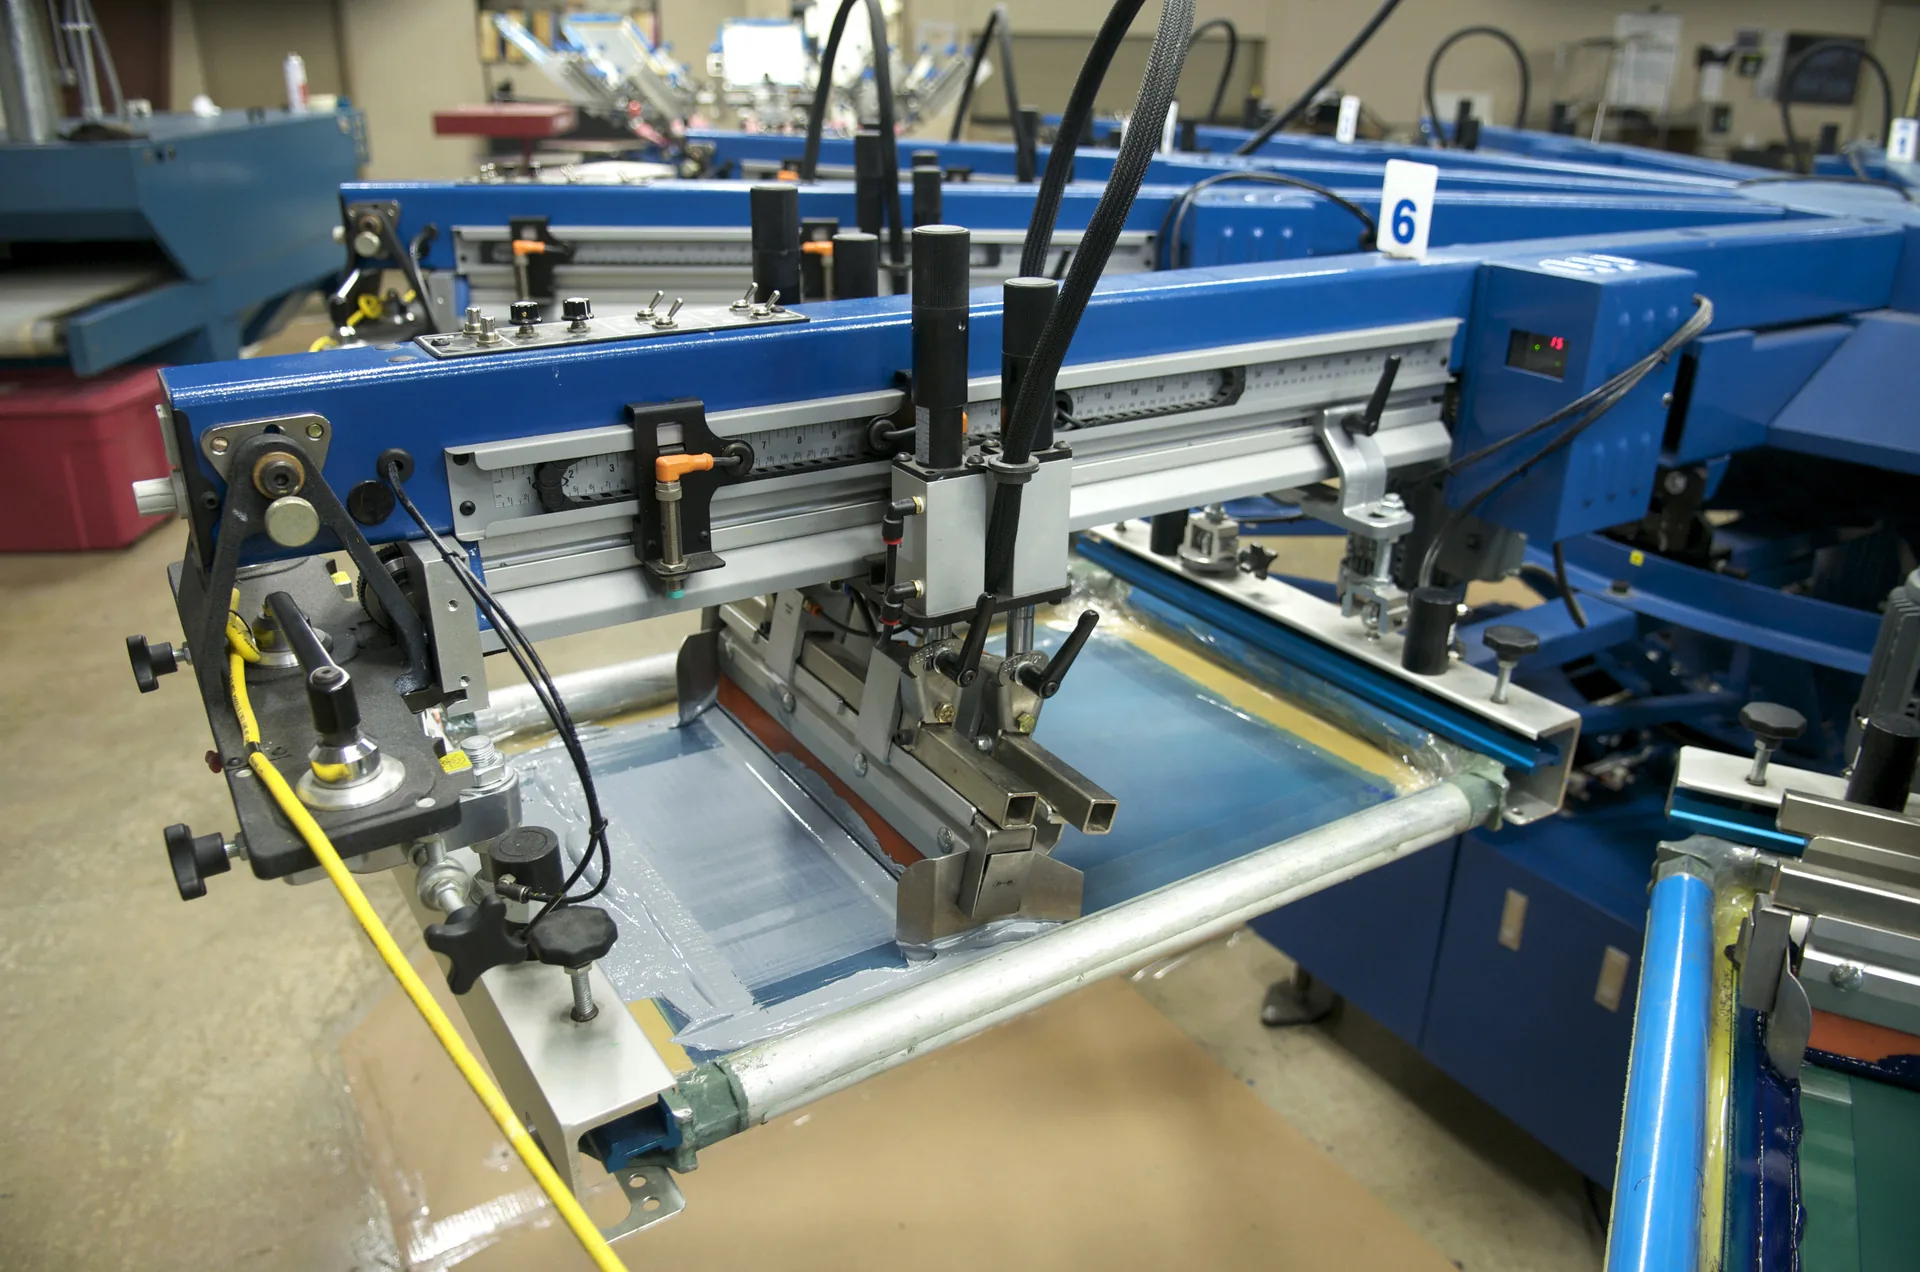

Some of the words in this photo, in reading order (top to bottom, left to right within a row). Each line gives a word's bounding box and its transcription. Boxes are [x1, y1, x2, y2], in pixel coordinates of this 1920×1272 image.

[1392, 198, 1417, 246] 6
[568, 470, 574, 479] 2
[609, 463, 615, 473] 3
